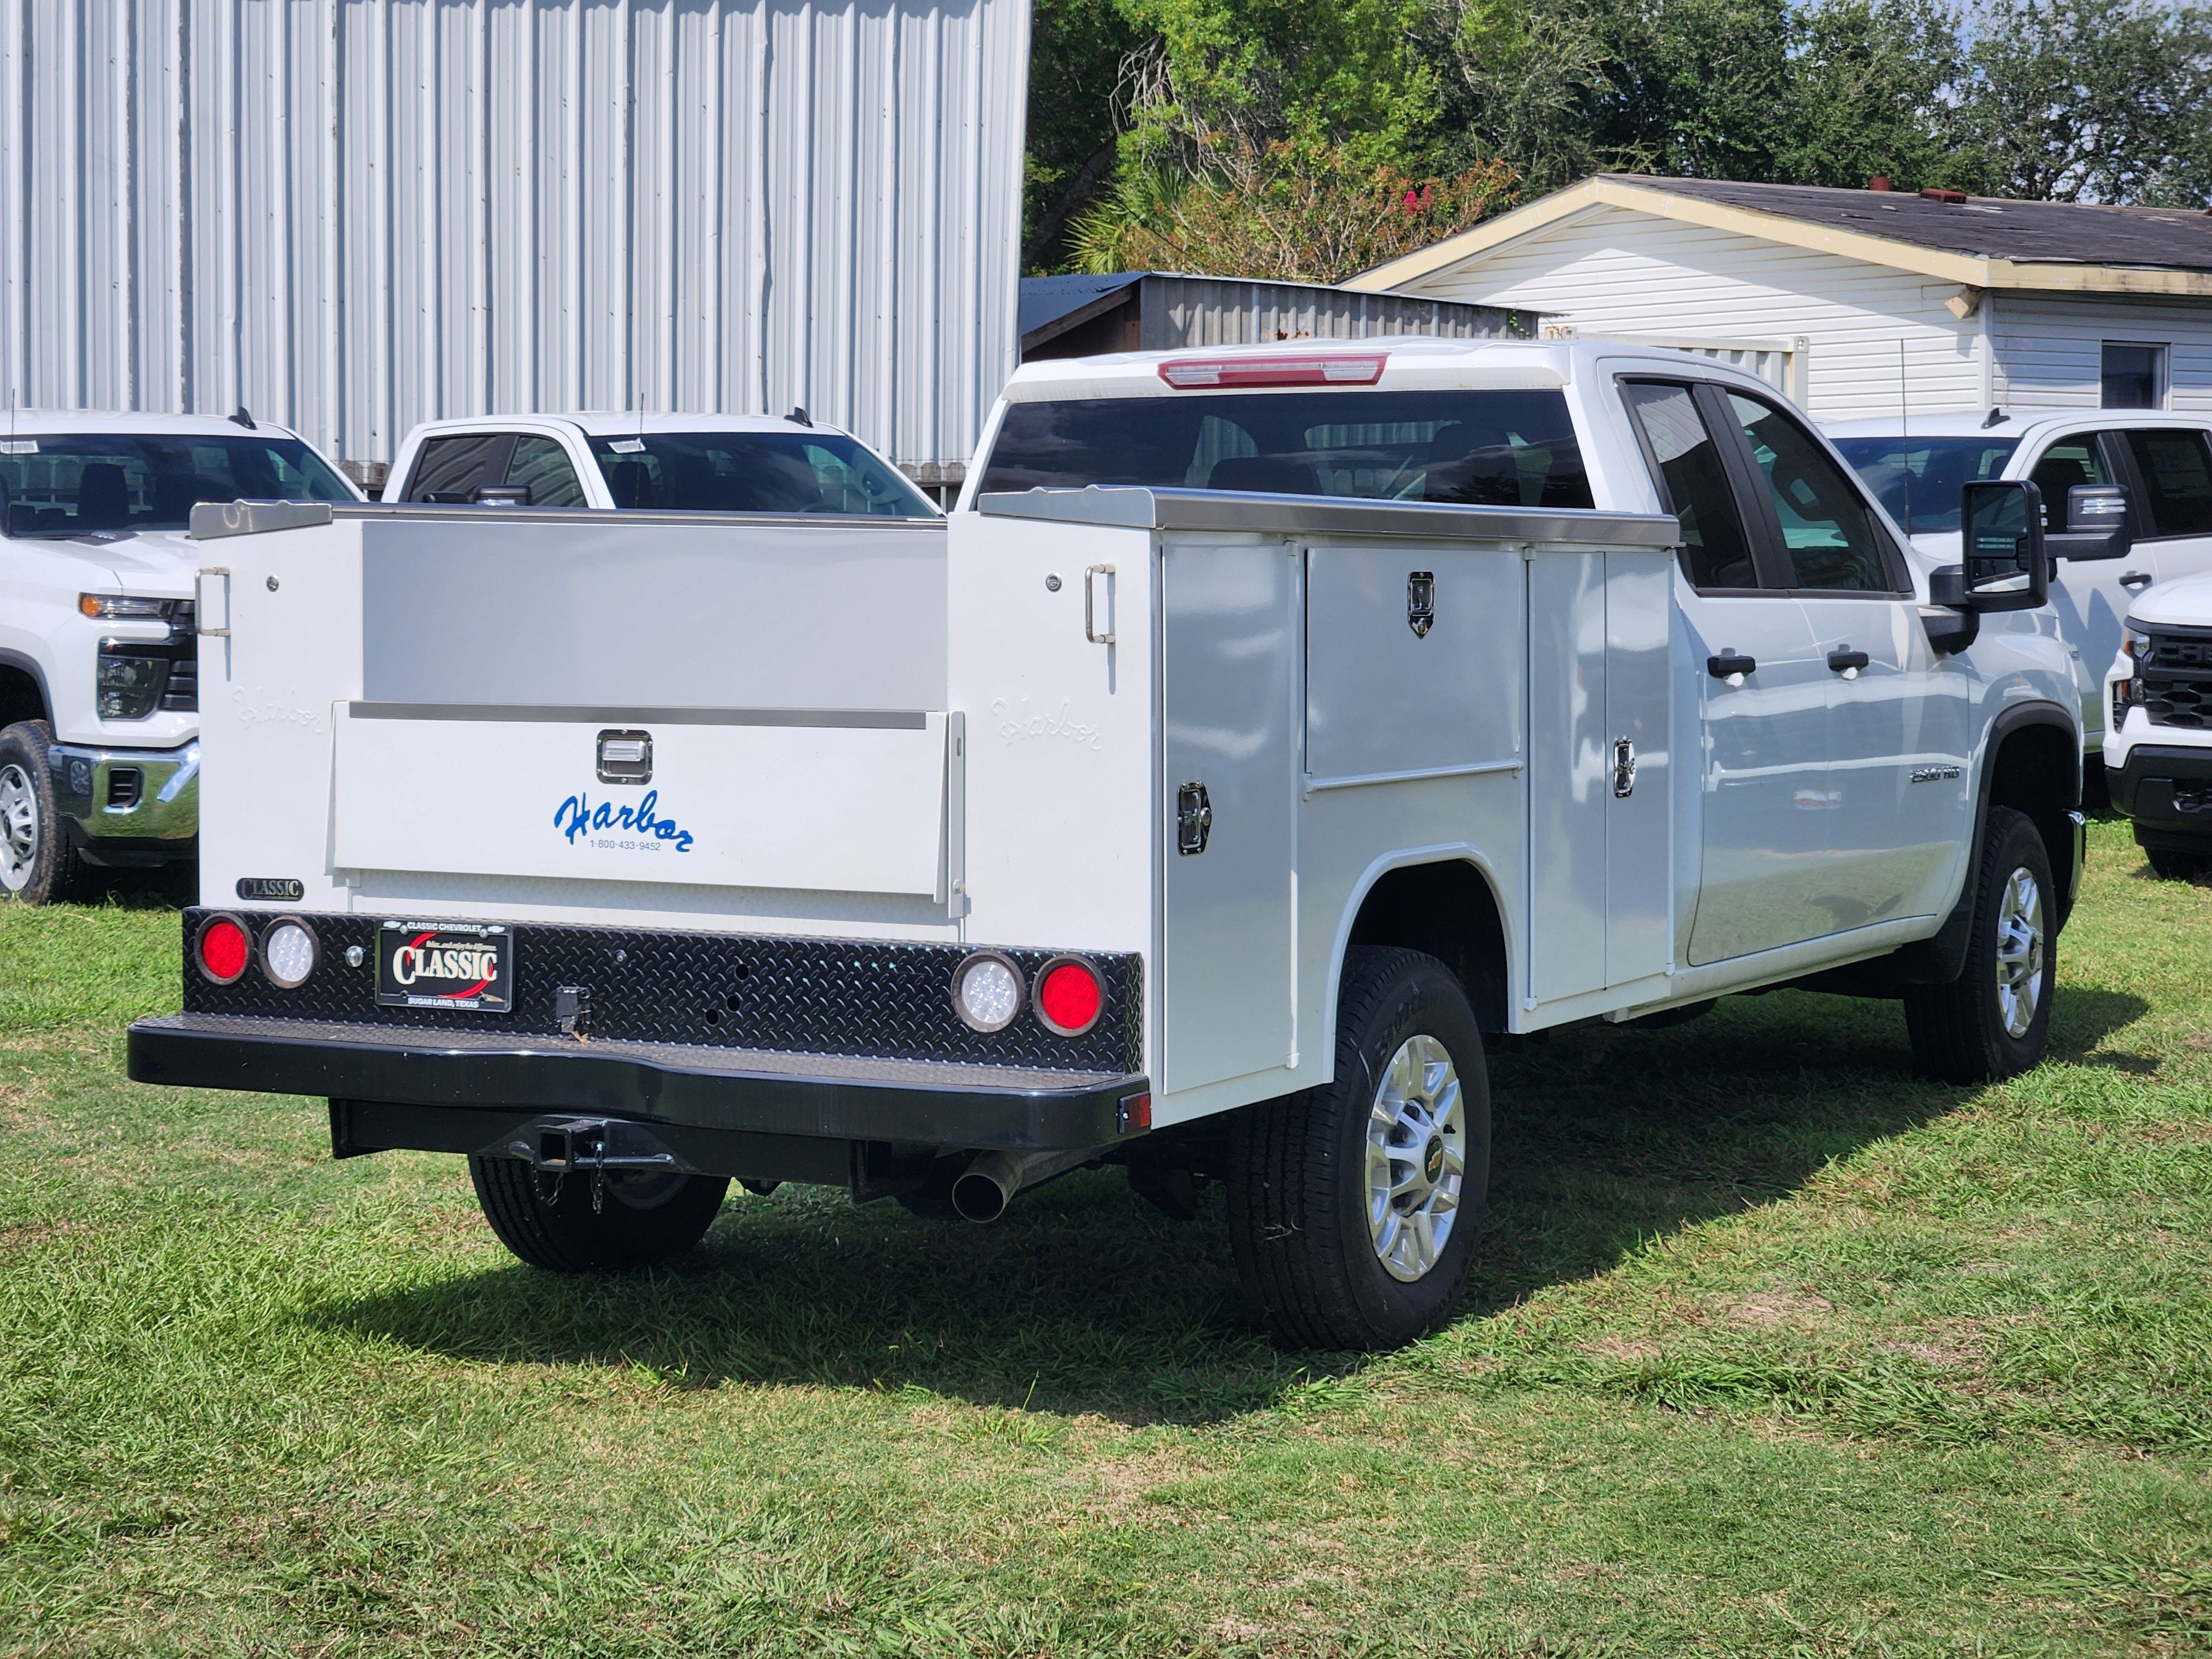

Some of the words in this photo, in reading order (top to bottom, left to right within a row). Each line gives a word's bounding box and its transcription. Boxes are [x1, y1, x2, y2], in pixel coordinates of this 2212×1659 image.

[554, 789, 694, 853] Harbor
[241, 879, 299, 899] CLASSIC
[406, 921, 438, 931] CLASSIC
[439, 923, 483, 932] CHEVROLET
[393, 946, 498, 985] CLASSIC
[407, 997, 432, 1005] SUGAR
[433, 999, 455, 1008] LAND,
[455, 1000, 479, 1008] TEXAS
